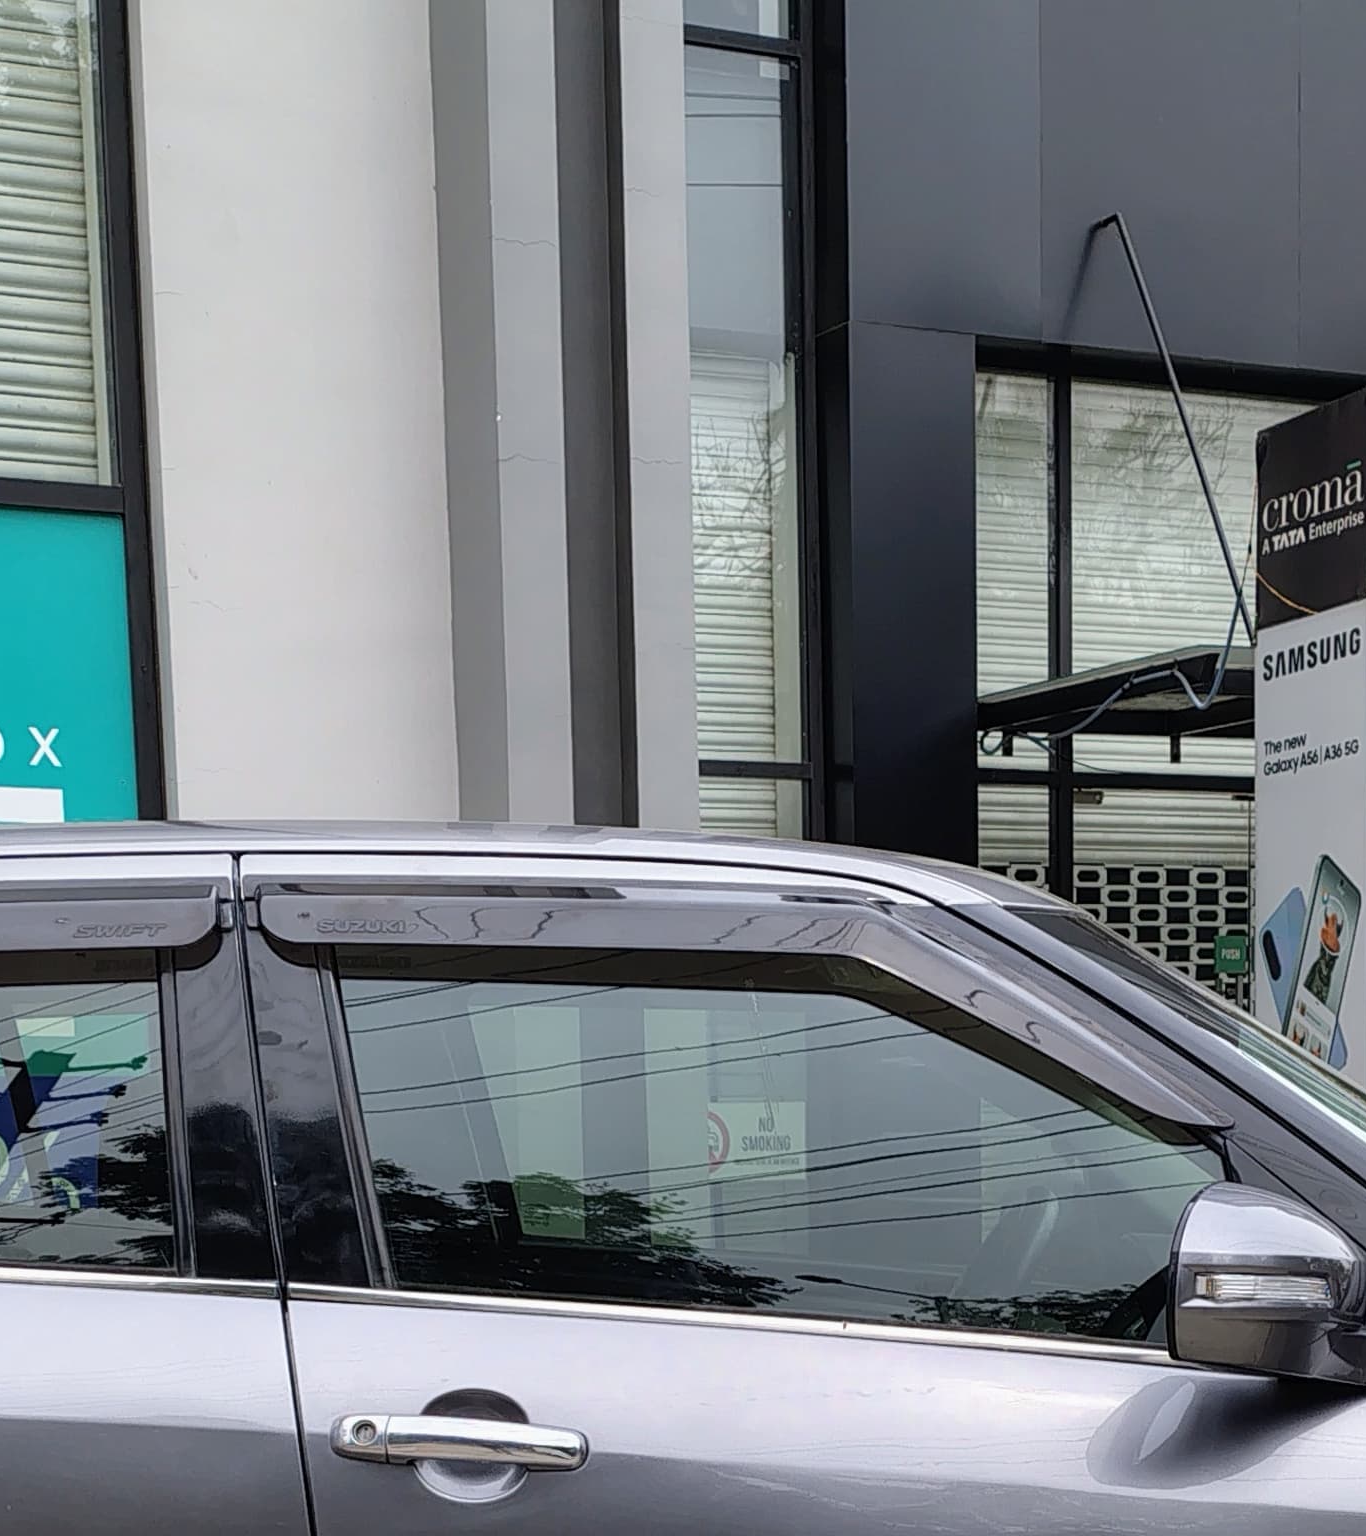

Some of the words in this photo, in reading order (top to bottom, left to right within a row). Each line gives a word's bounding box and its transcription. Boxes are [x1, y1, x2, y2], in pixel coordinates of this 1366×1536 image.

[1261, 536, 1271, 555] A
[1272, 527, 1306, 551] TATA
[1308, 509, 1365, 541] Enterprise
[1262, 626, 1362, 682] SAMSUNG
[1263, 739, 1283, 757] The
[1284, 733, 1308, 751] new
[1263, 756, 1300, 776] Galaxy
[72, 922, 168, 939] SWIFT
[315, 919, 407, 935] SUZUKI
[757, 1116, 775, 1133] NO
[741, 1134, 792, 1152] SMOKING
